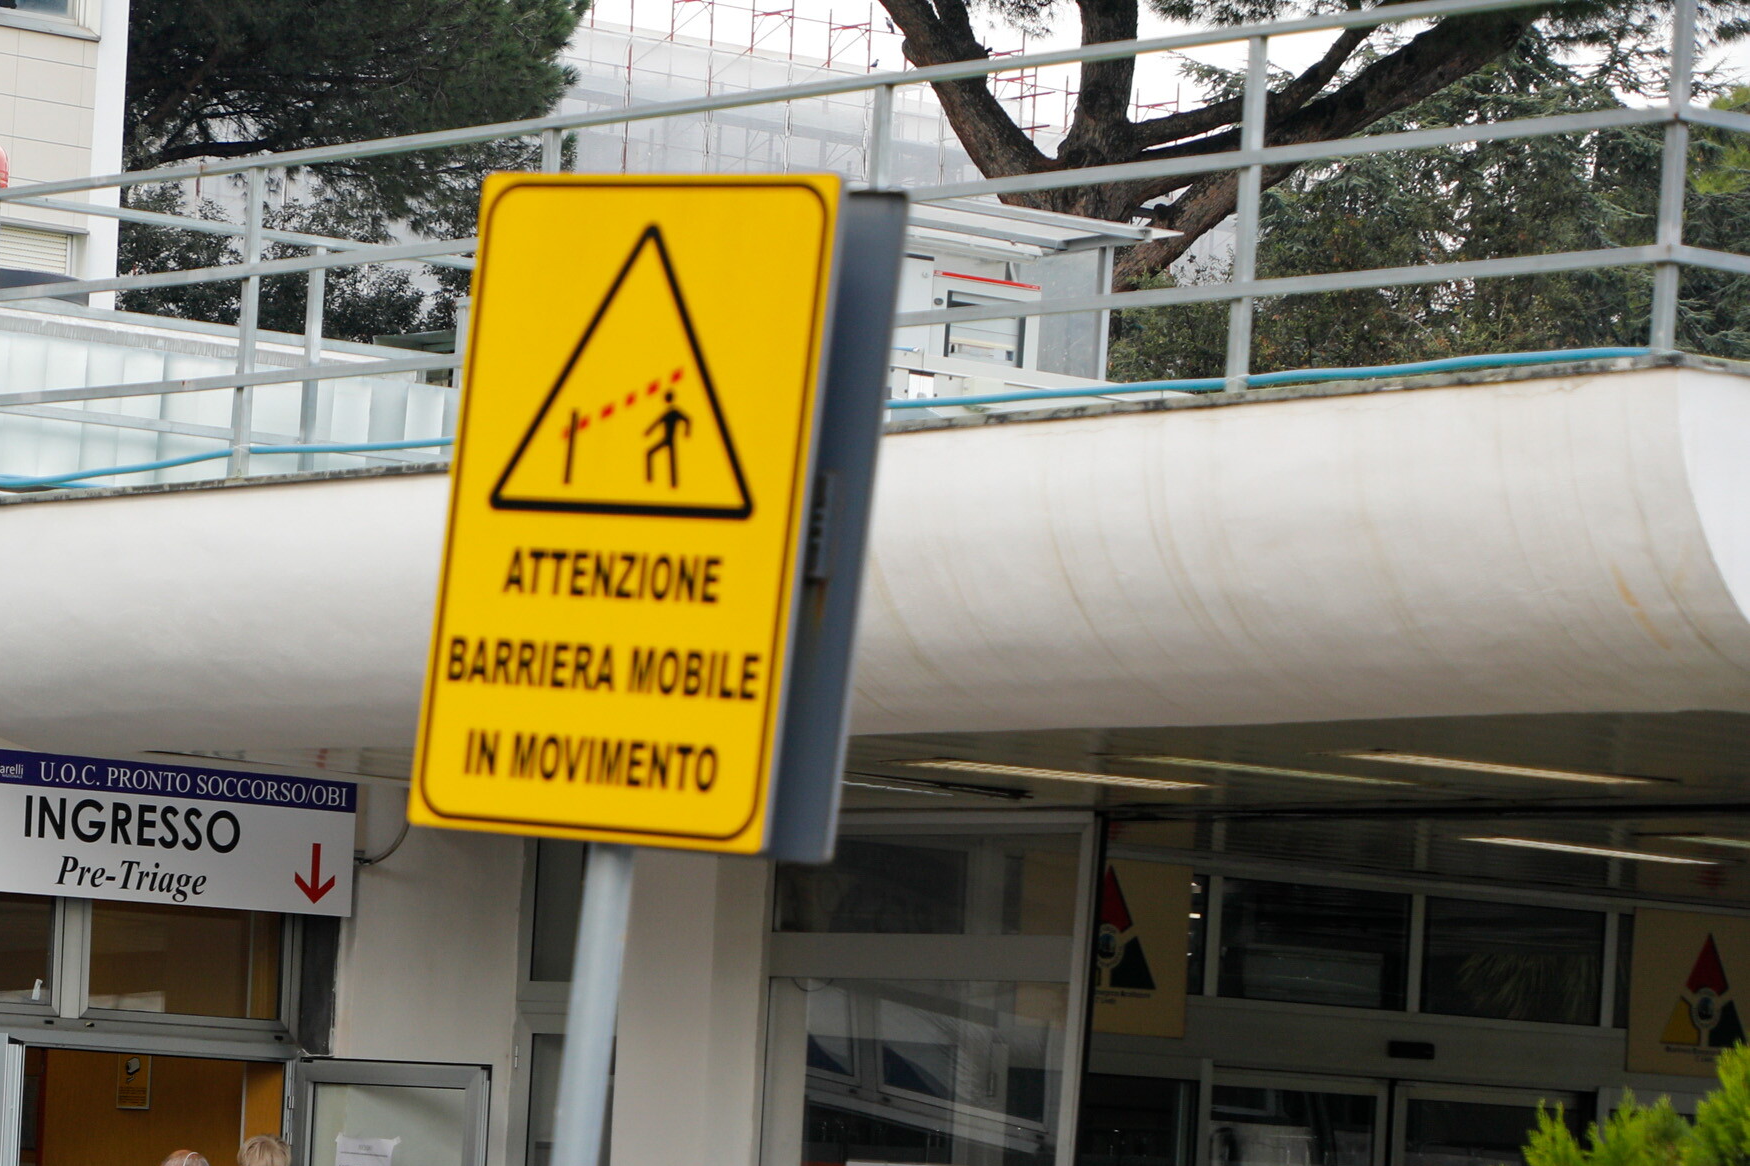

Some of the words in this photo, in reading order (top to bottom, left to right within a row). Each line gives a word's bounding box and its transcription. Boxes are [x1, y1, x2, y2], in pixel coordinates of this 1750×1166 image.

[503, 547, 723, 603] ATTENZIONE
[446, 636, 615, 692] BARRIERA
[627, 646, 761, 700] MOBILE
[39, 761, 100, 786] U.O.C.
[106, 766, 191, 793] PRONTO
[196, 774, 348, 807] SOCCORSO/OBI
[464, 729, 500, 776] IN
[509, 732, 719, 792] MOVIMENTO
[24, 795, 240, 853] INGRESSO
[54, 855, 207, 903] Pre-Triage
